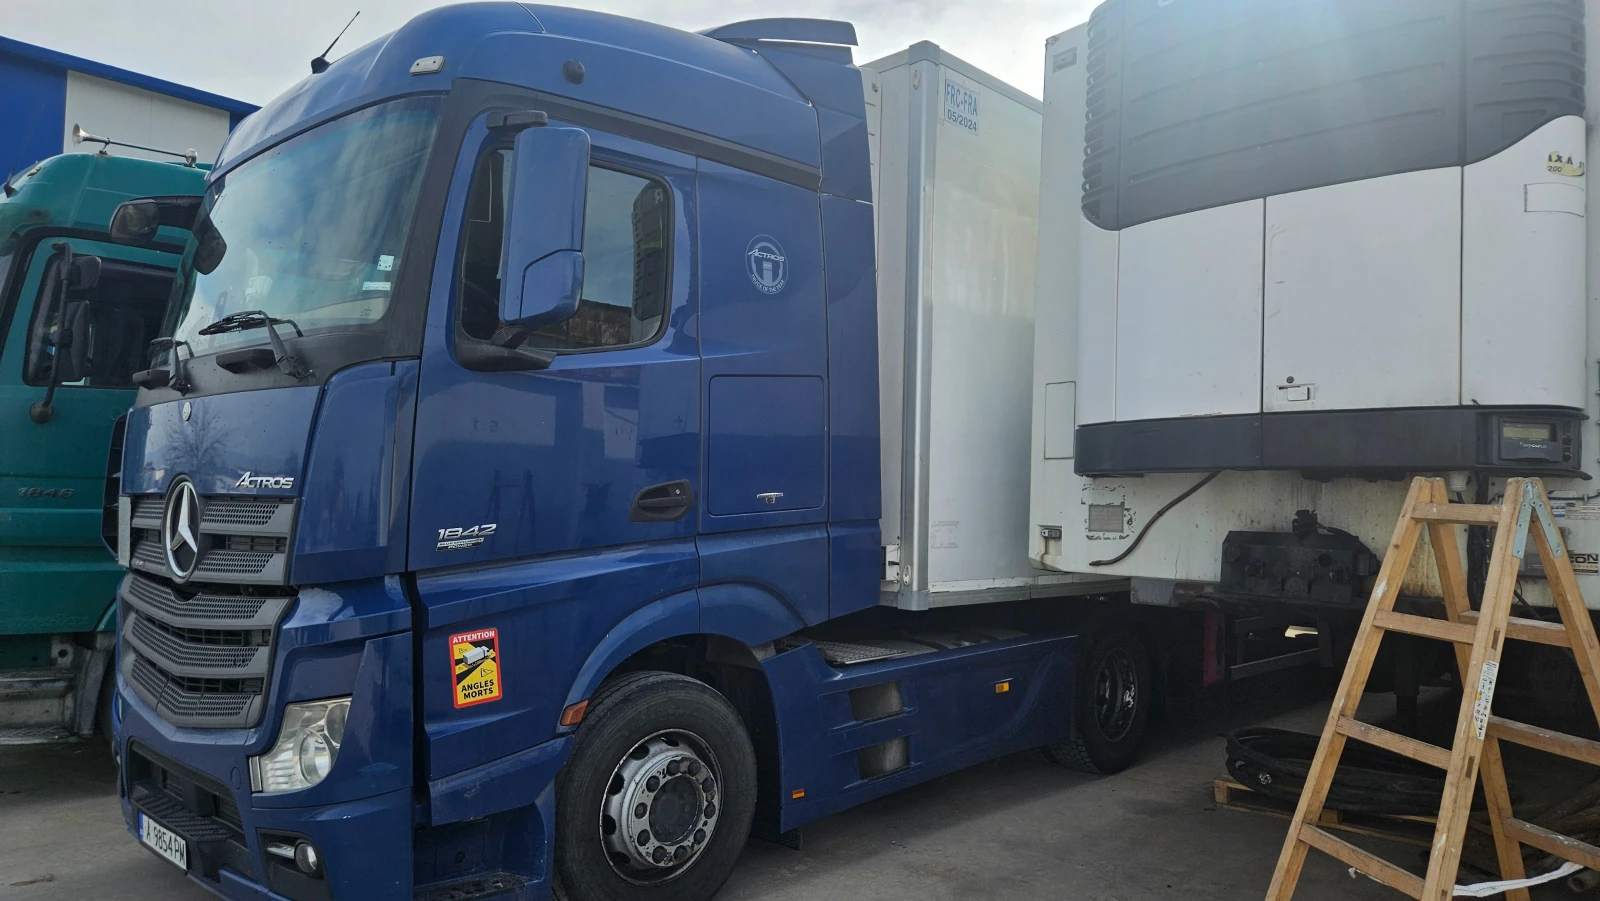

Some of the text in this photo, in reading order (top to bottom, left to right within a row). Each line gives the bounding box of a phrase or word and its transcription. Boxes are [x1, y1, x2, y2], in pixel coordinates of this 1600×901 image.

[946, 82, 978, 117] FRC-FRA
[947, 109, 977, 132] 05/2024
[438, 523, 497, 541] 1842
[453, 631, 495, 644] ATTENTION
[461, 679, 495, 693] ANGLES
[464, 687, 494, 700] MORTS
[147, 820, 151, 841] A
[153, 826, 173, 857] 9854
